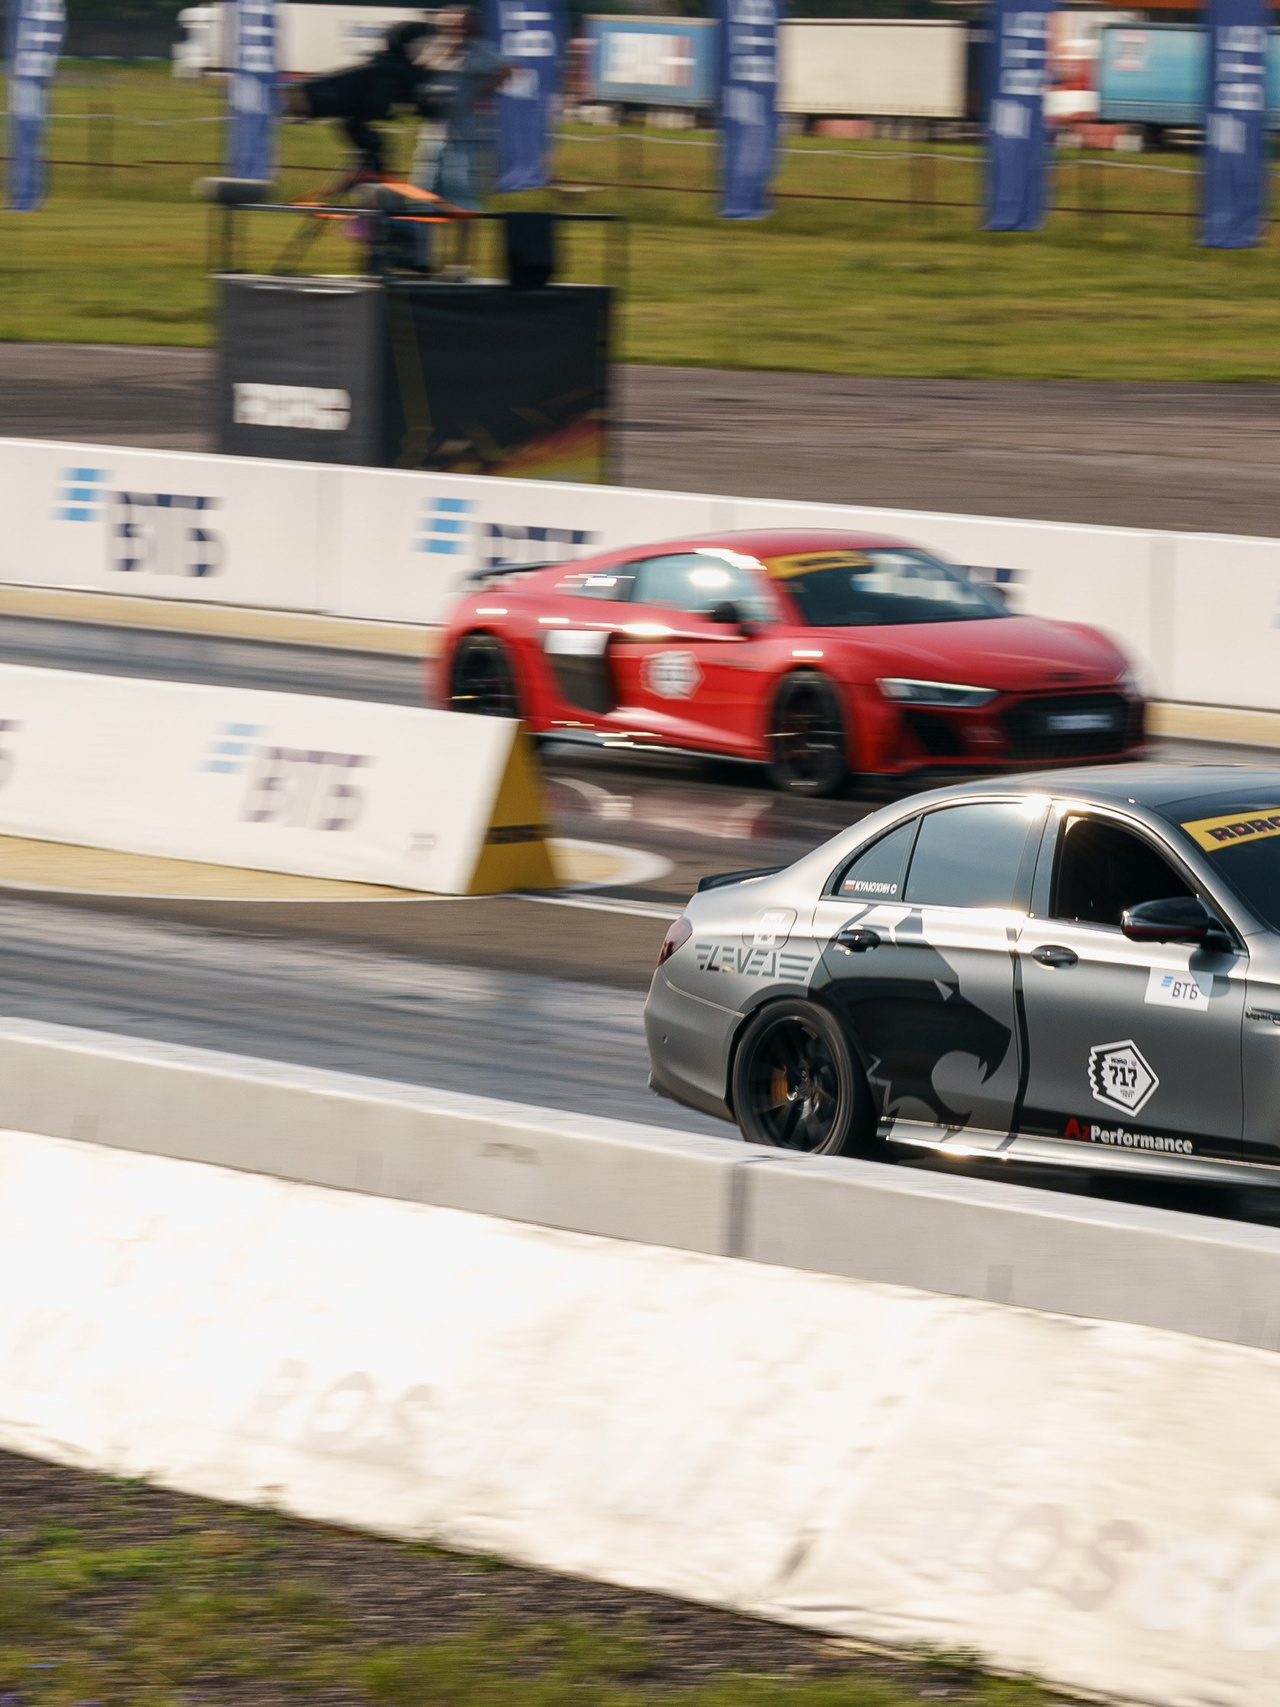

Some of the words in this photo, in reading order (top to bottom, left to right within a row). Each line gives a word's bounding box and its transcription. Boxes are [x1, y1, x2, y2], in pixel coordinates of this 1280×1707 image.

[109, 490, 224, 577] ВТБ
[1172, 981, 1200, 1000] ВТБ
[1109, 1065, 1137, 1088] 717
